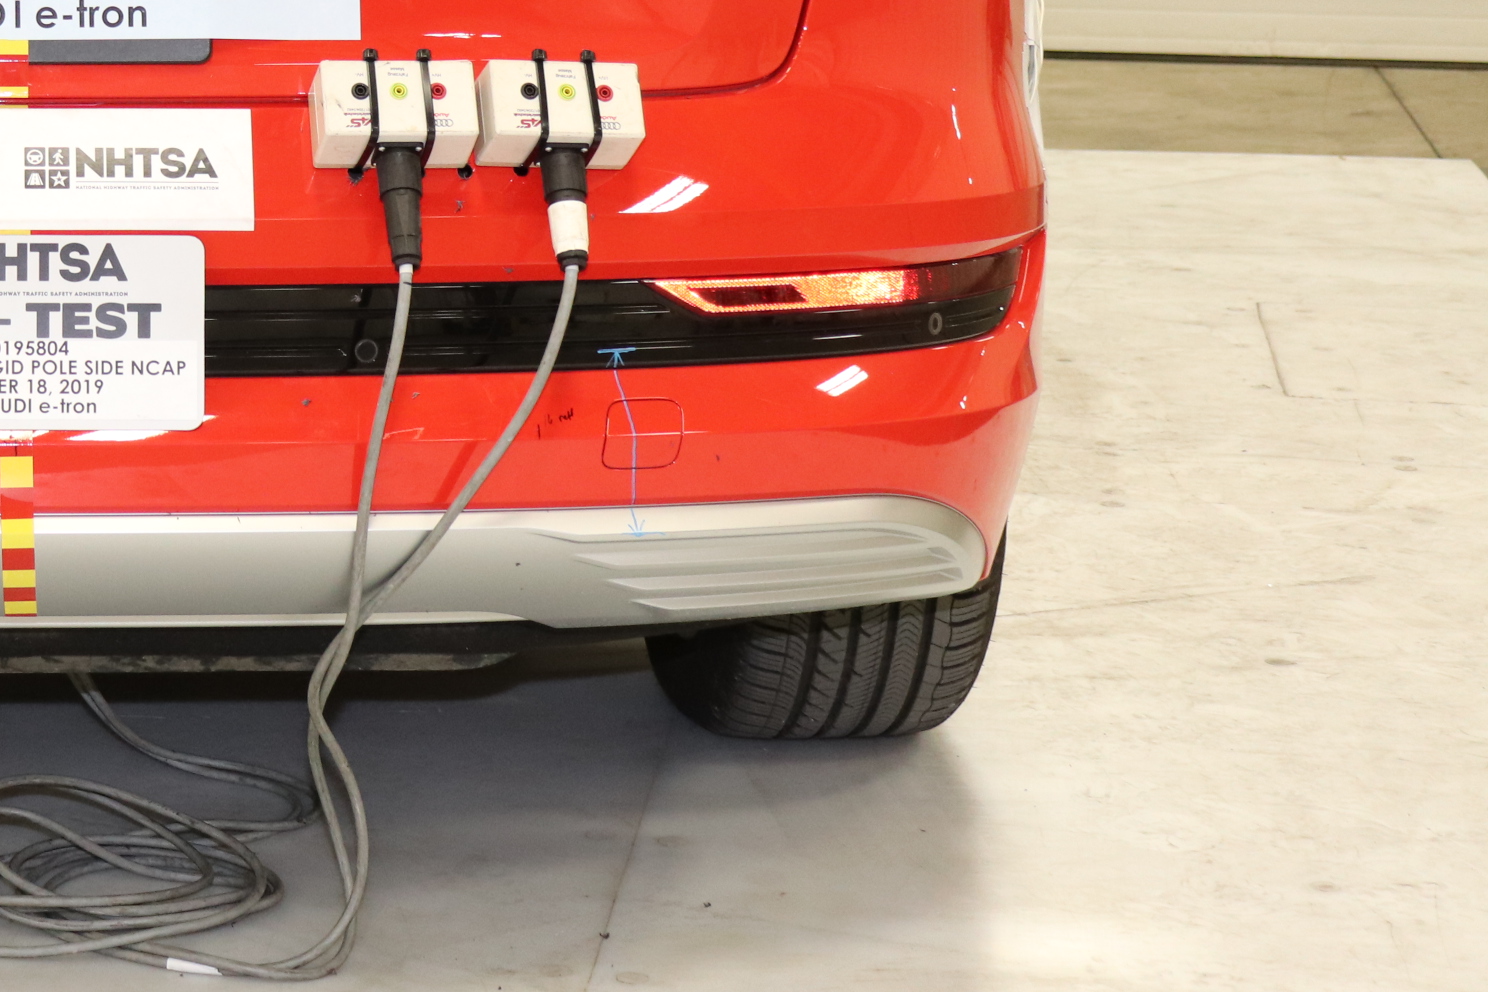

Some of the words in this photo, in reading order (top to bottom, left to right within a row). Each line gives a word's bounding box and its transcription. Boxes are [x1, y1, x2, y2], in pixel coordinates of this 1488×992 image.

[35, 0, 147, 29] e-tron
[76, 147, 218, 179] NHTSA
[25, 302, 162, 339] TEST
[31, 359, 77, 375] POLE
[84, 360, 124, 375] SIDE
[131, 360, 186, 376] NCAP
[27, 378, 53, 396] 18,
[59, 378, 104, 395] 2019
[39, 398, 97, 414] e-tron
